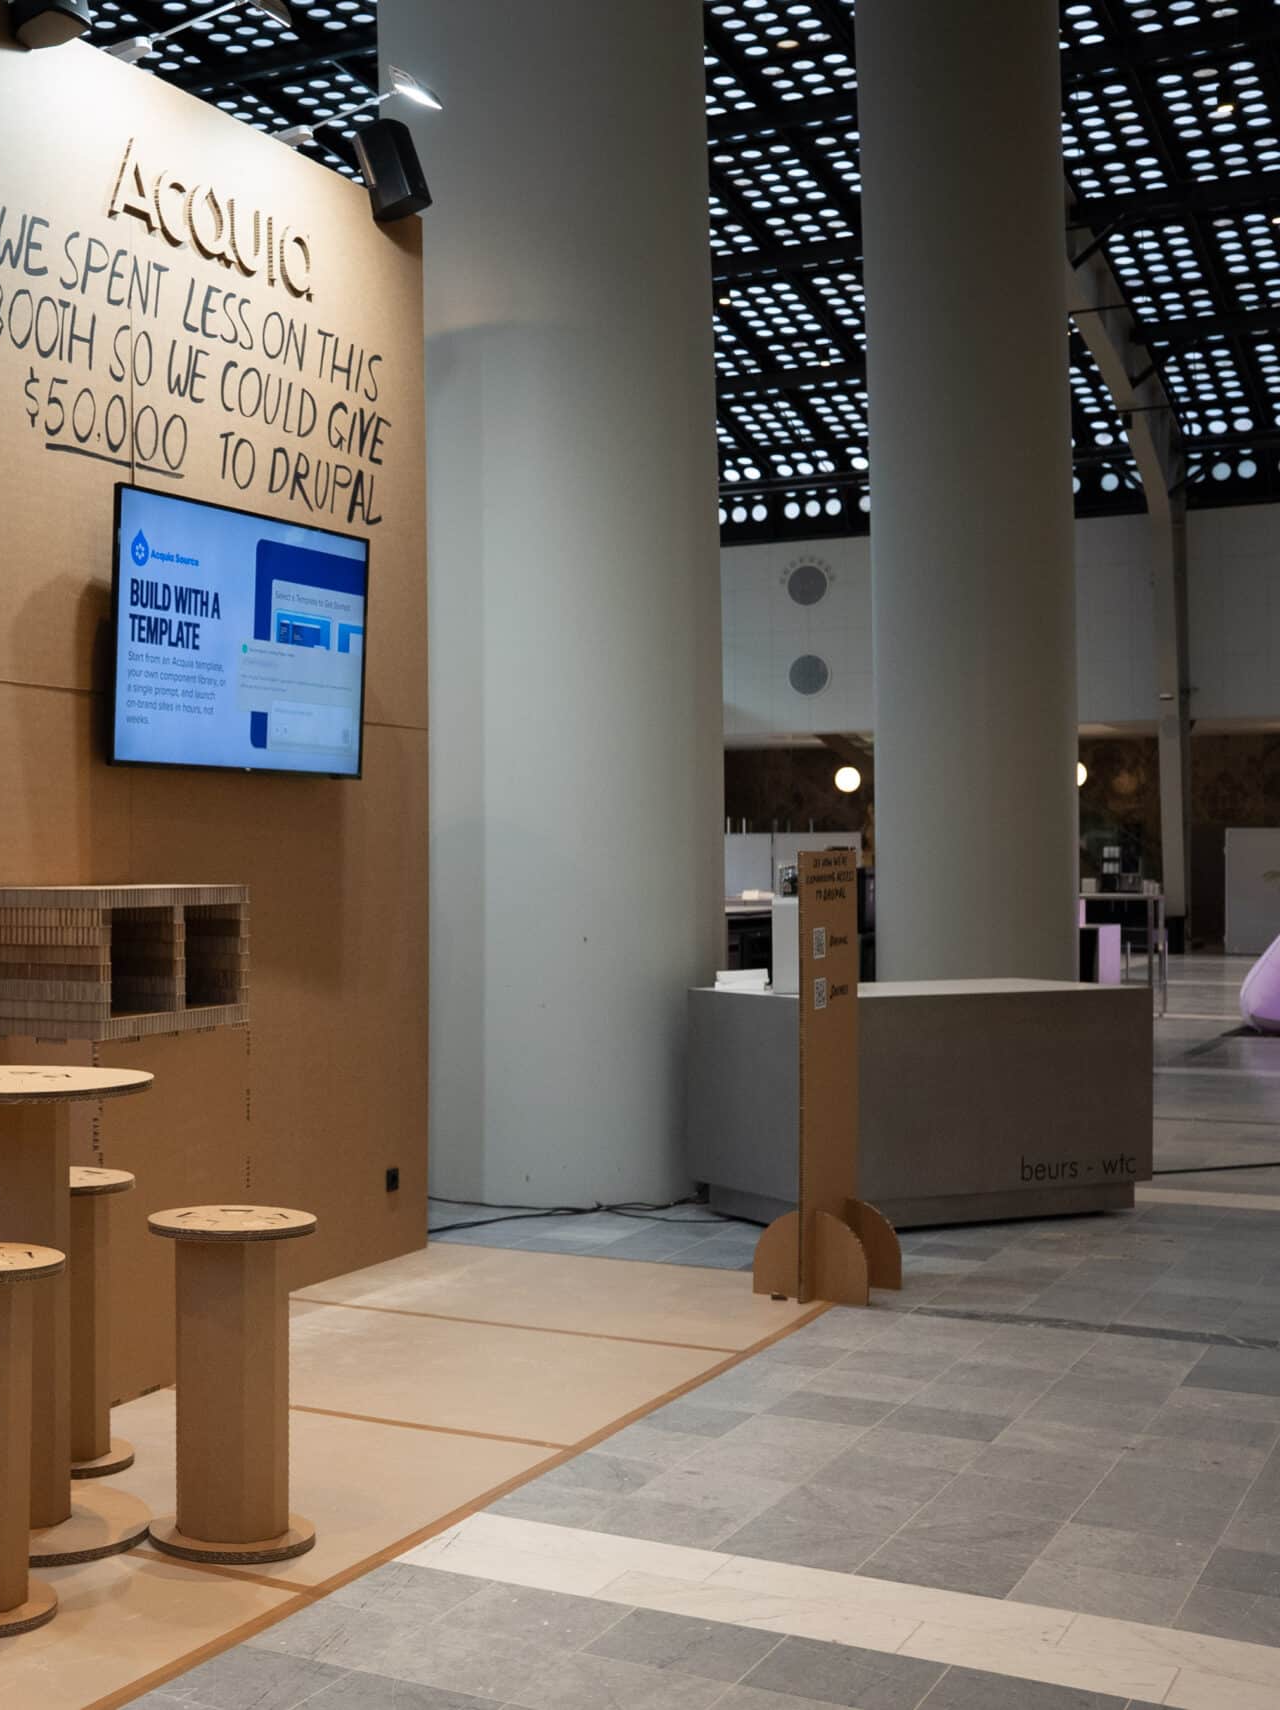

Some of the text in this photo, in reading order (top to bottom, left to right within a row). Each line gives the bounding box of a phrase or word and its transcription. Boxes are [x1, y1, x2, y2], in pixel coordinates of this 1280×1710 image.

[59, 231, 170, 319] SPENT
[182, 277, 254, 350] LESS
[262, 311, 308, 372] ON
[317, 328, 383, 402] THIS
[109, 324, 153, 387] SO
[167, 339, 210, 404] WE
[220, 360, 318, 438] COULD
[327, 401, 392, 466] GIVE
[219, 431, 256, 490] TO
[268, 447, 383, 525] DRUPAL
[150, 549, 200, 567] Acquia Source
[130, 577, 222, 620] BUILD WITH A
[128, 612, 201, 651] TEMPLATE
[128, 650, 144, 662] Start
[145, 653, 161, 664] from
[162, 656, 171, 665] an
[172, 656, 194, 669] Acquia
[127, 668, 143, 681] your
[143, 671, 159, 680] own
[160, 671, 197, 684] component
[132, 683, 154, 697] single
[180, 688, 194, 698] and
[158, 701, 174, 712] sites
[203, 706, 215, 716] not
[1021, 1155, 1079, 1182] beurs
[1102, 1152, 1137, 1176] wtc
